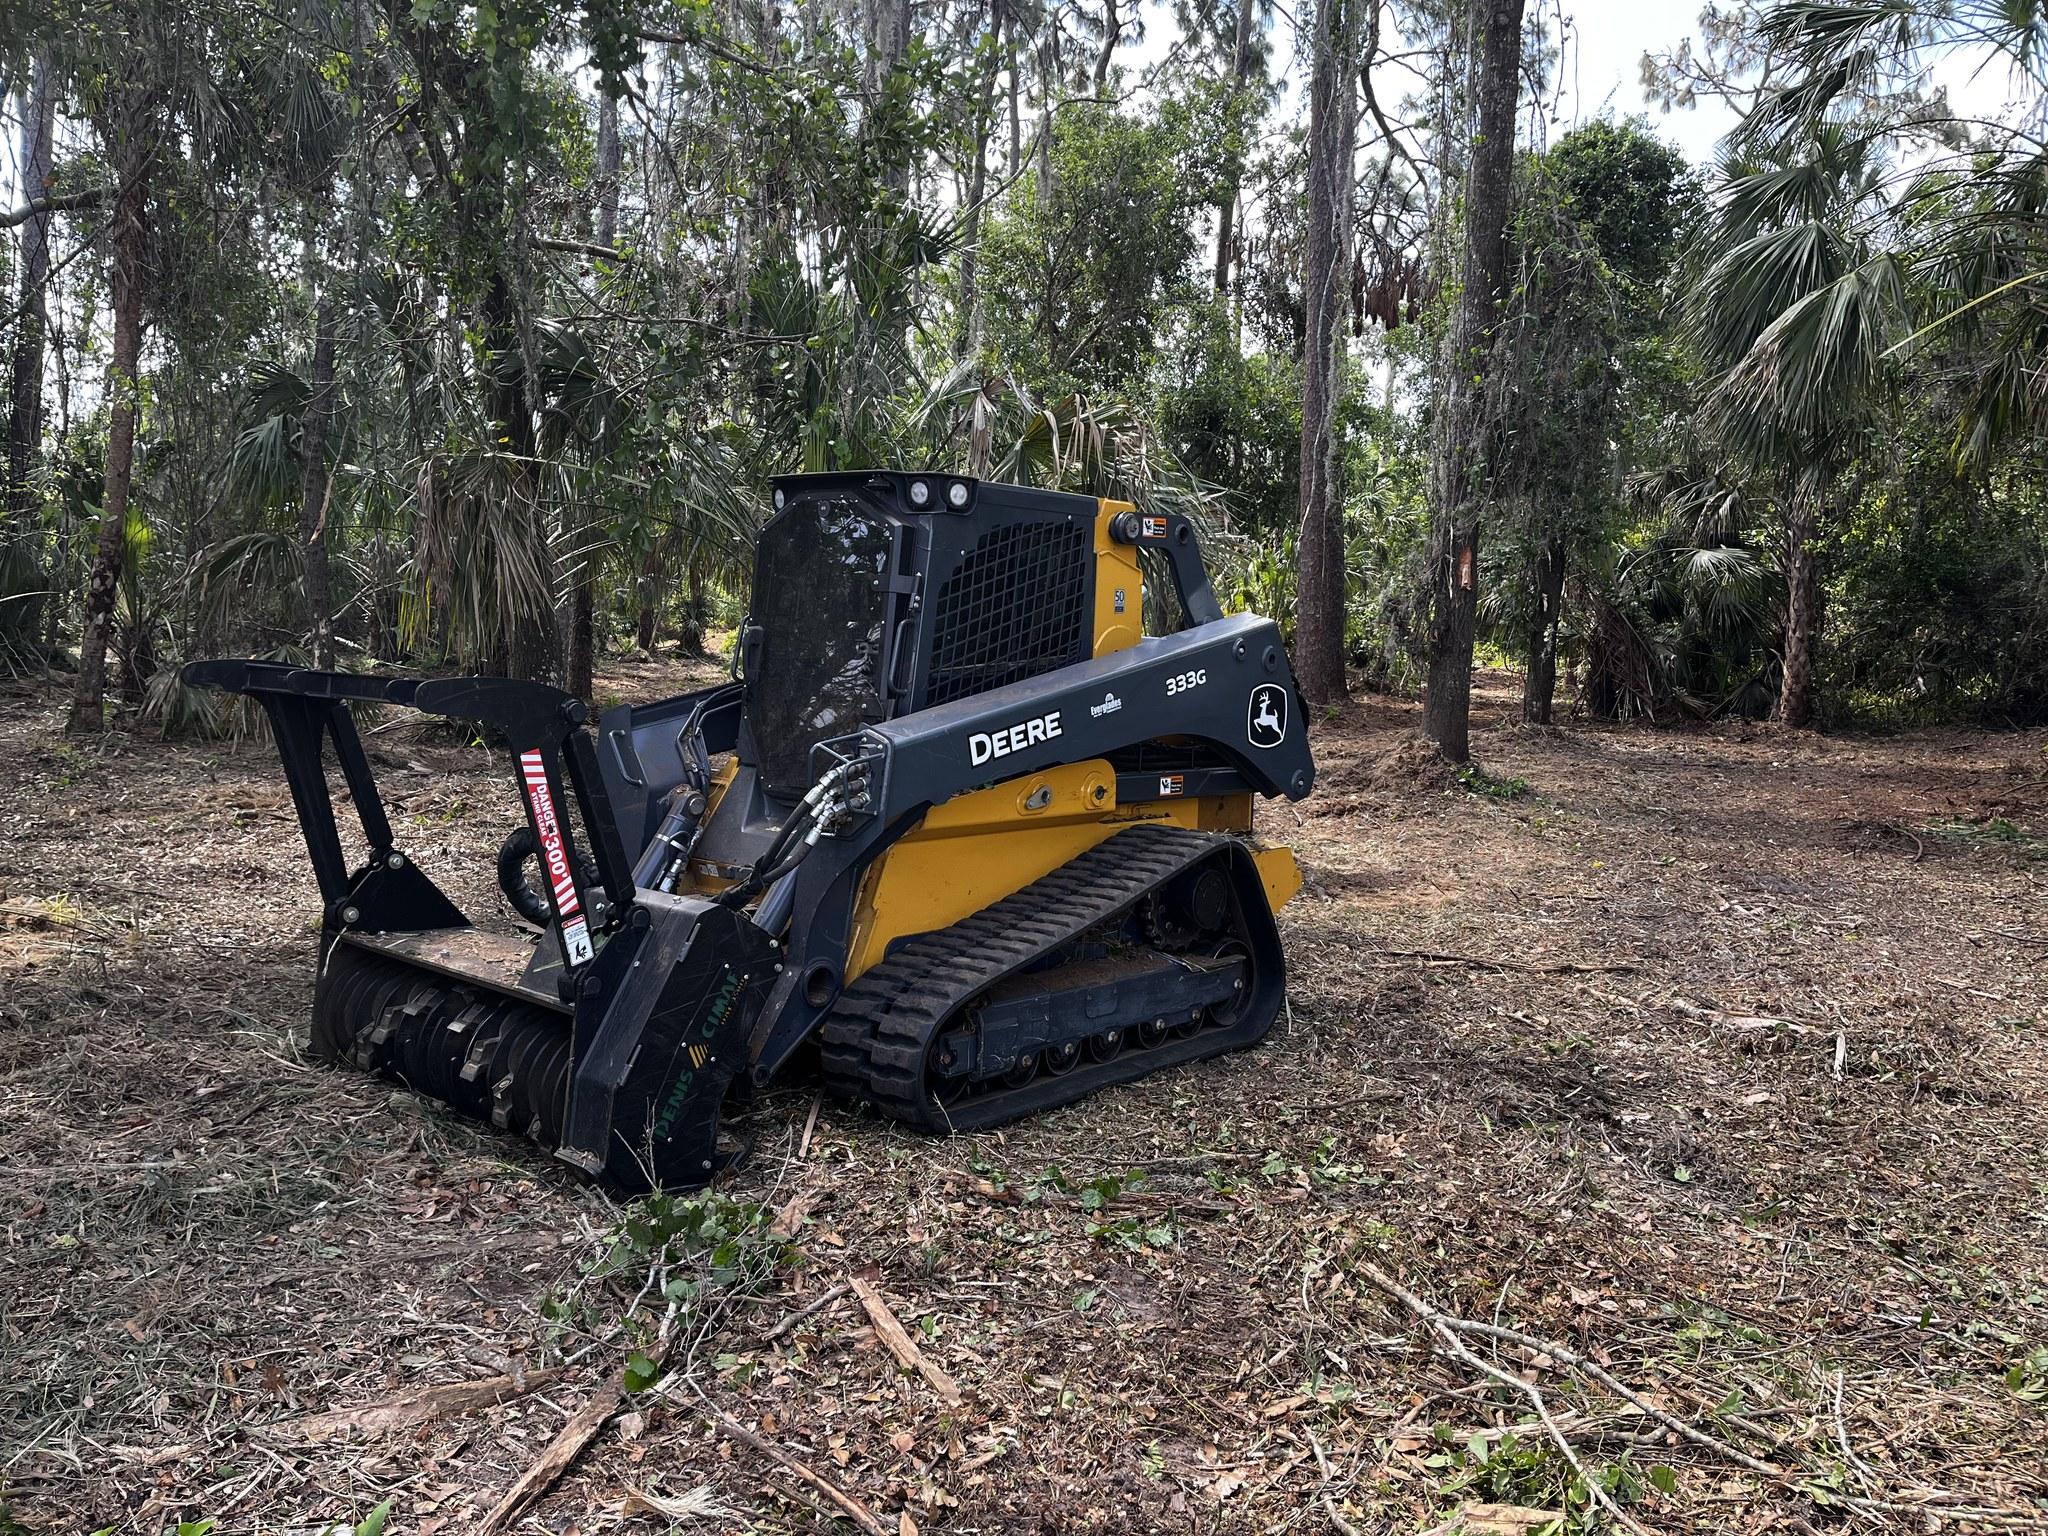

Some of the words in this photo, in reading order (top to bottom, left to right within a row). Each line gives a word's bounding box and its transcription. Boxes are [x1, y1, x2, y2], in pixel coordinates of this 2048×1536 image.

[1166, 669, 1207, 696] 333G
[968, 711, 1062, 767] DEERE
[531, 792, 541, 815] STAND
[536, 783, 557, 837] DANGER
[535, 814, 547, 837] CLEAR
[655, 1070, 694, 1139] DENIS
[702, 972, 738, 1039] CIMAF
